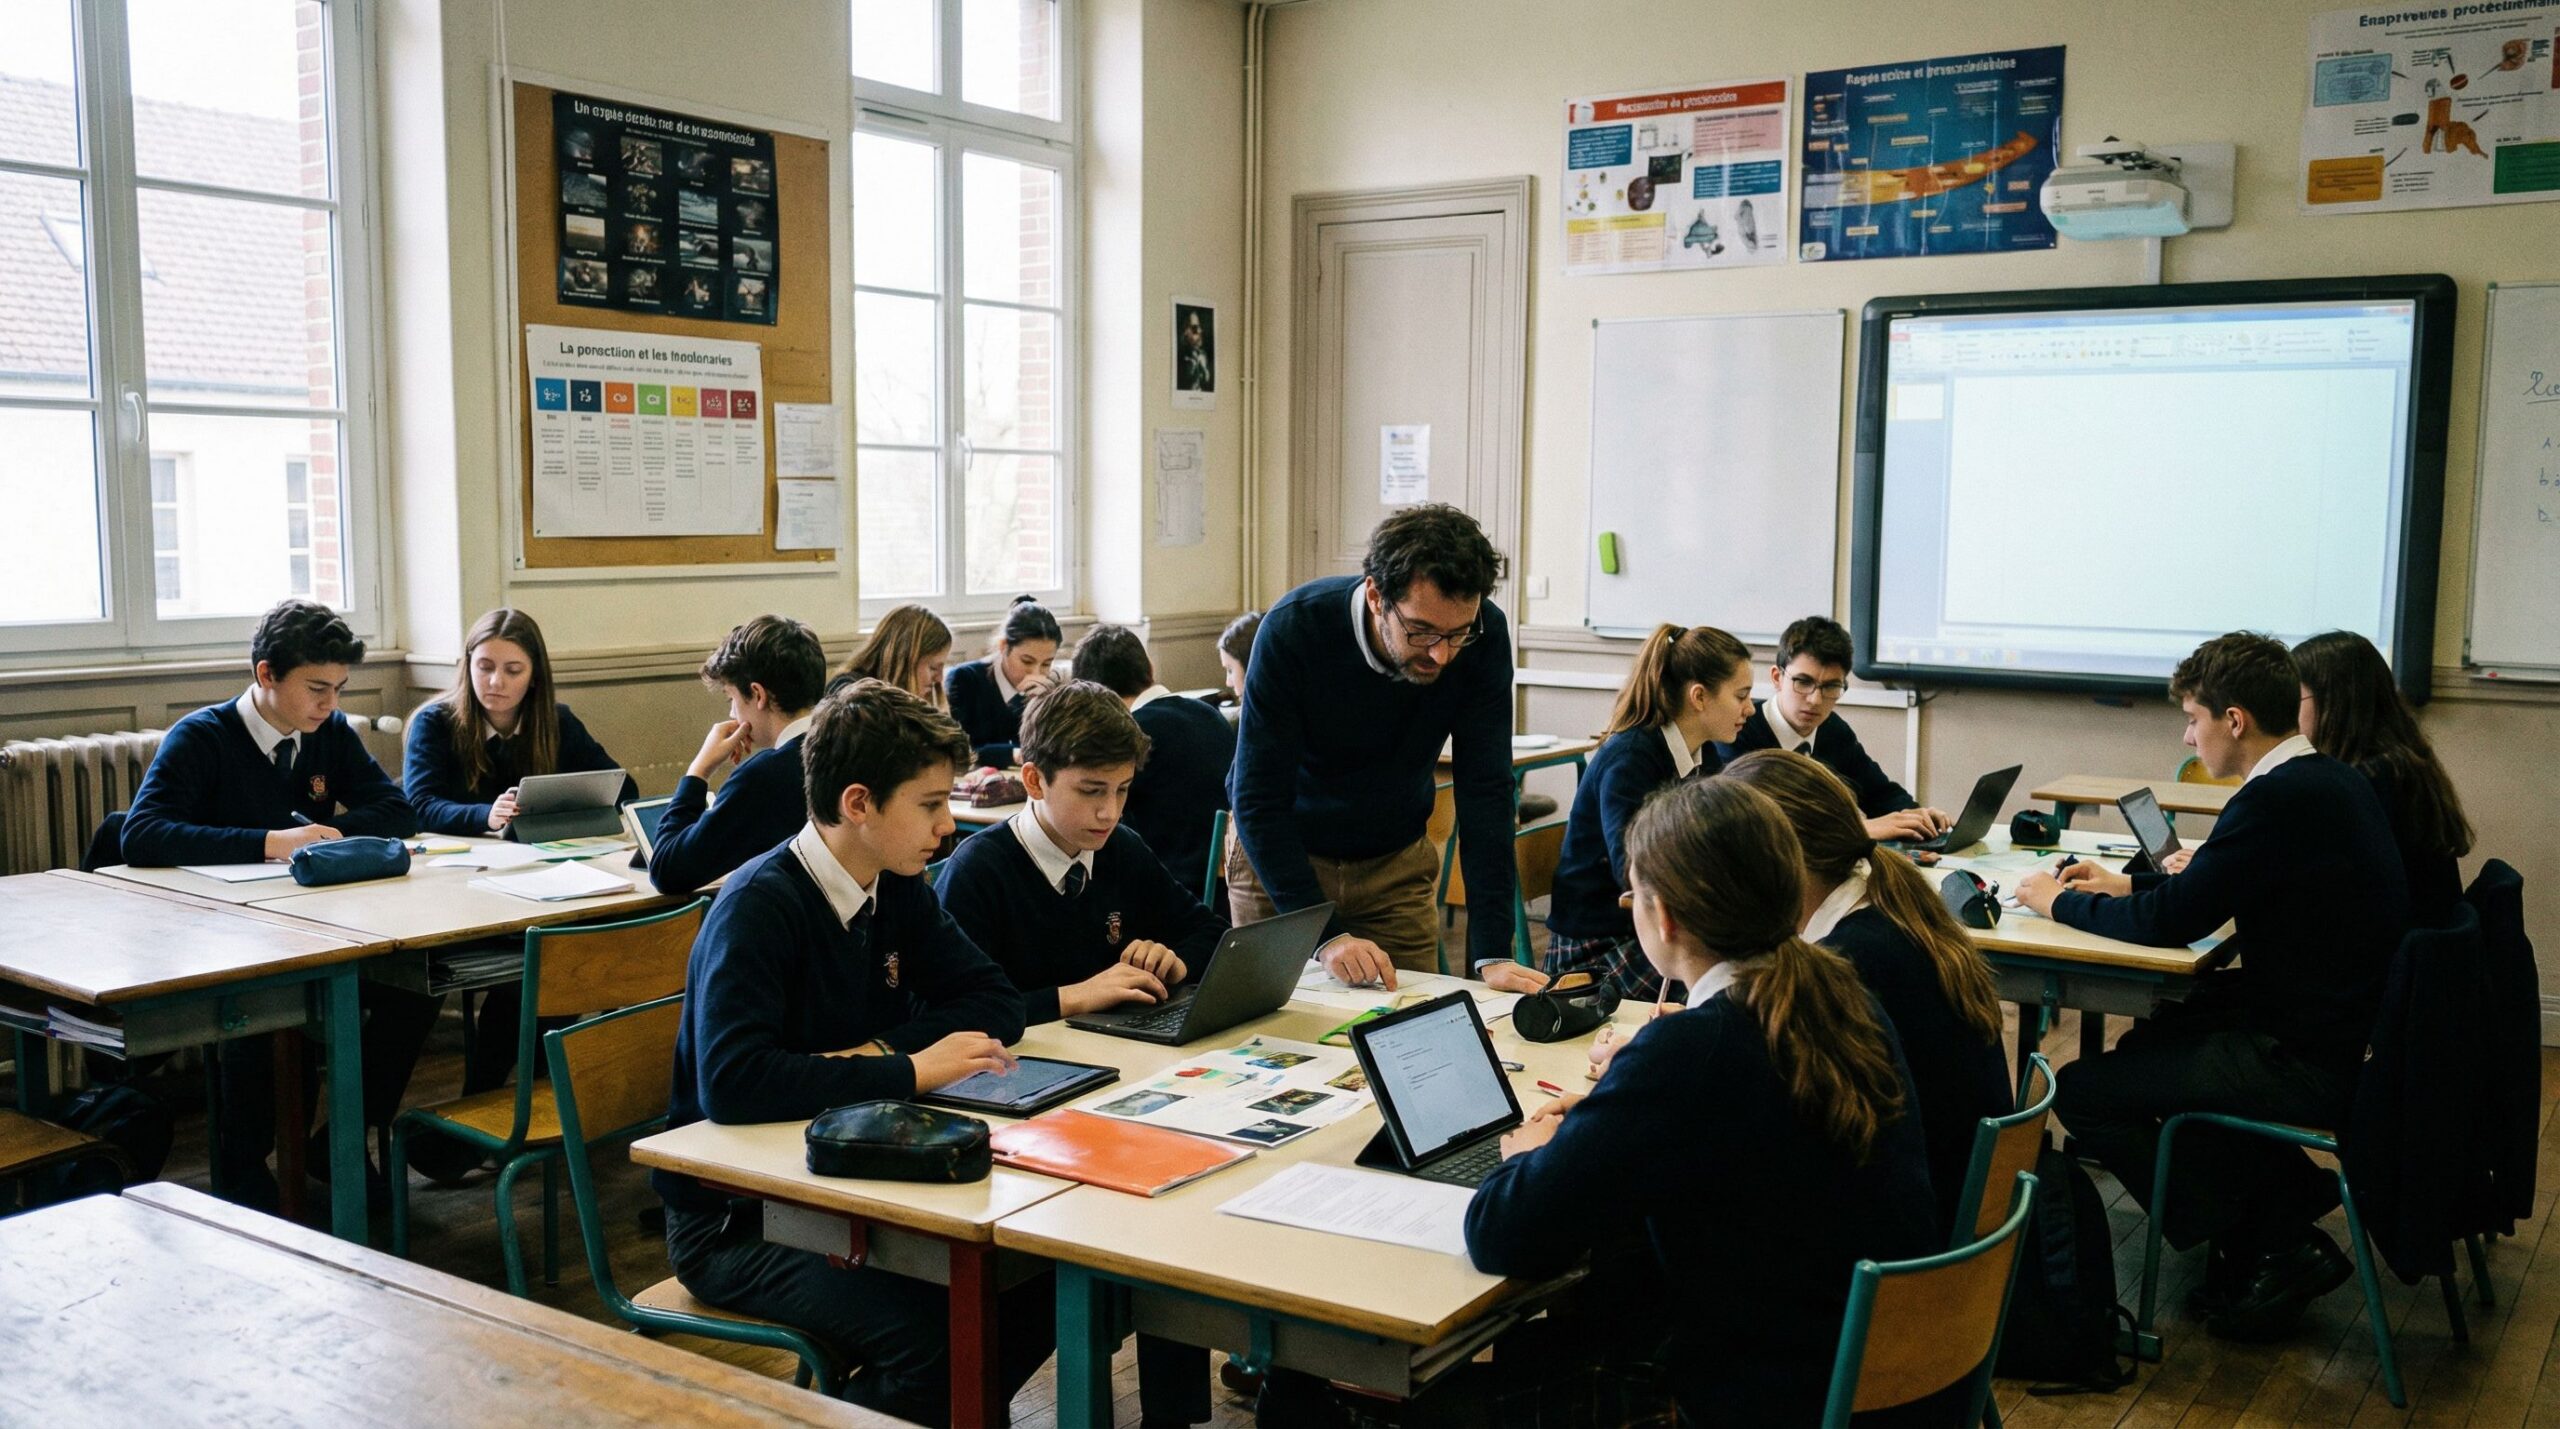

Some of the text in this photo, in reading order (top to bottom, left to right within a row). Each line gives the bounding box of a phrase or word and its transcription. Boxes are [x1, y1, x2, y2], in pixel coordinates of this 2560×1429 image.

[574, 100, 590, 115] Un
[560, 342, 574, 354] La
[638, 349, 649, 359] et
[652, 348, 668, 361] les
